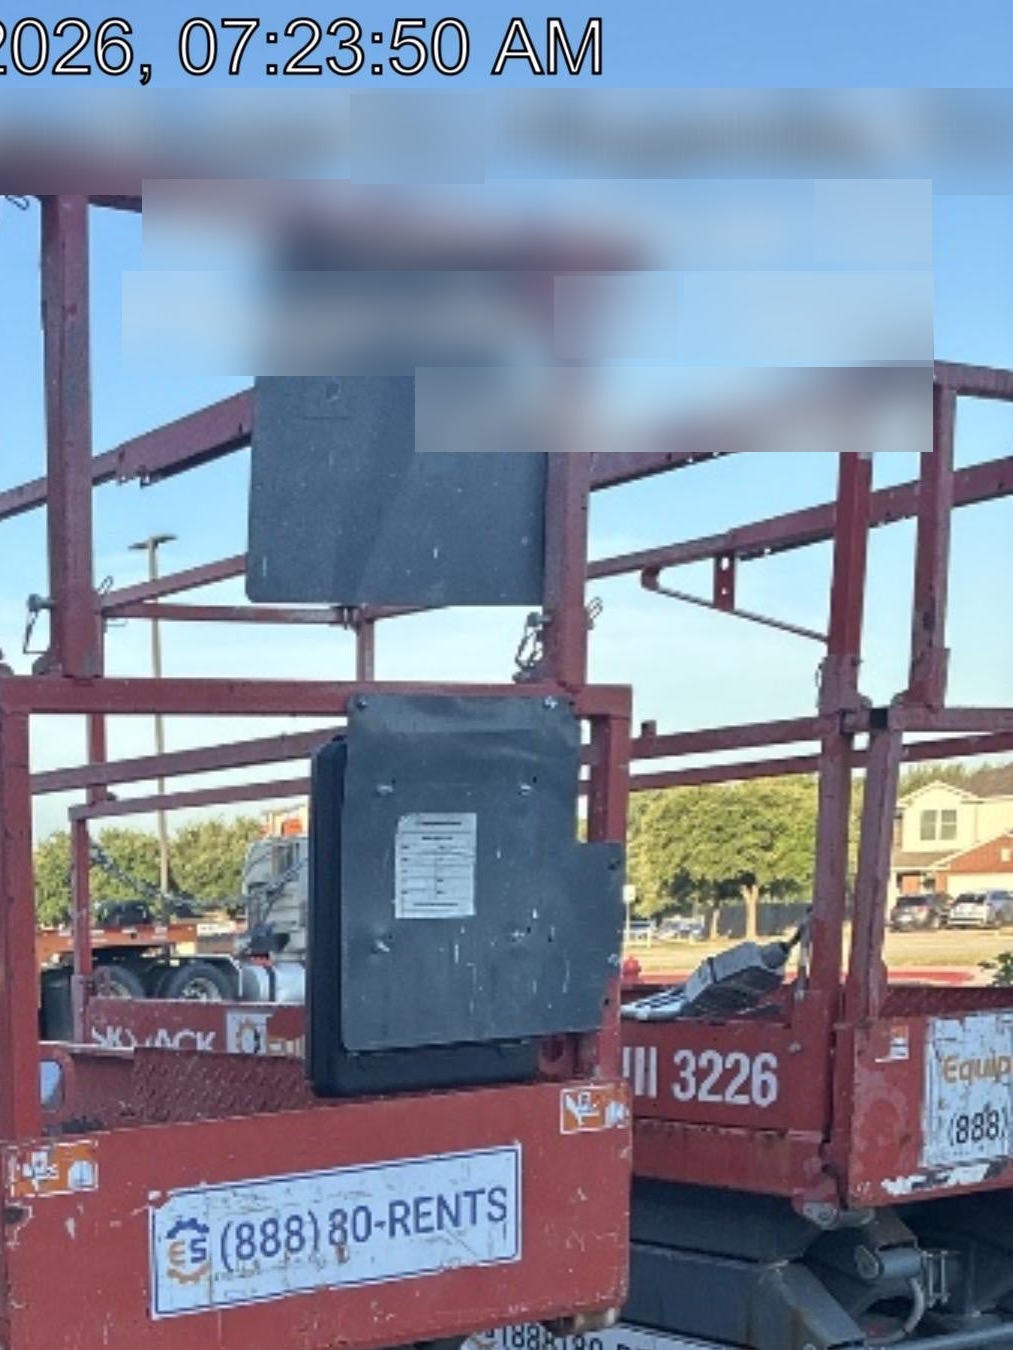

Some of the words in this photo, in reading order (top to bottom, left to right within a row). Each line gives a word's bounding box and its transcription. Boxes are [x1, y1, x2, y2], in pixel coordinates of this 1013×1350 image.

[673, 1050, 778, 1108] 3226
[948, 1106, 1008, 1147] (888)
[220, 1210, 321, 1273] (888)
[328, 1187, 509, 1249] 80-RENTS
